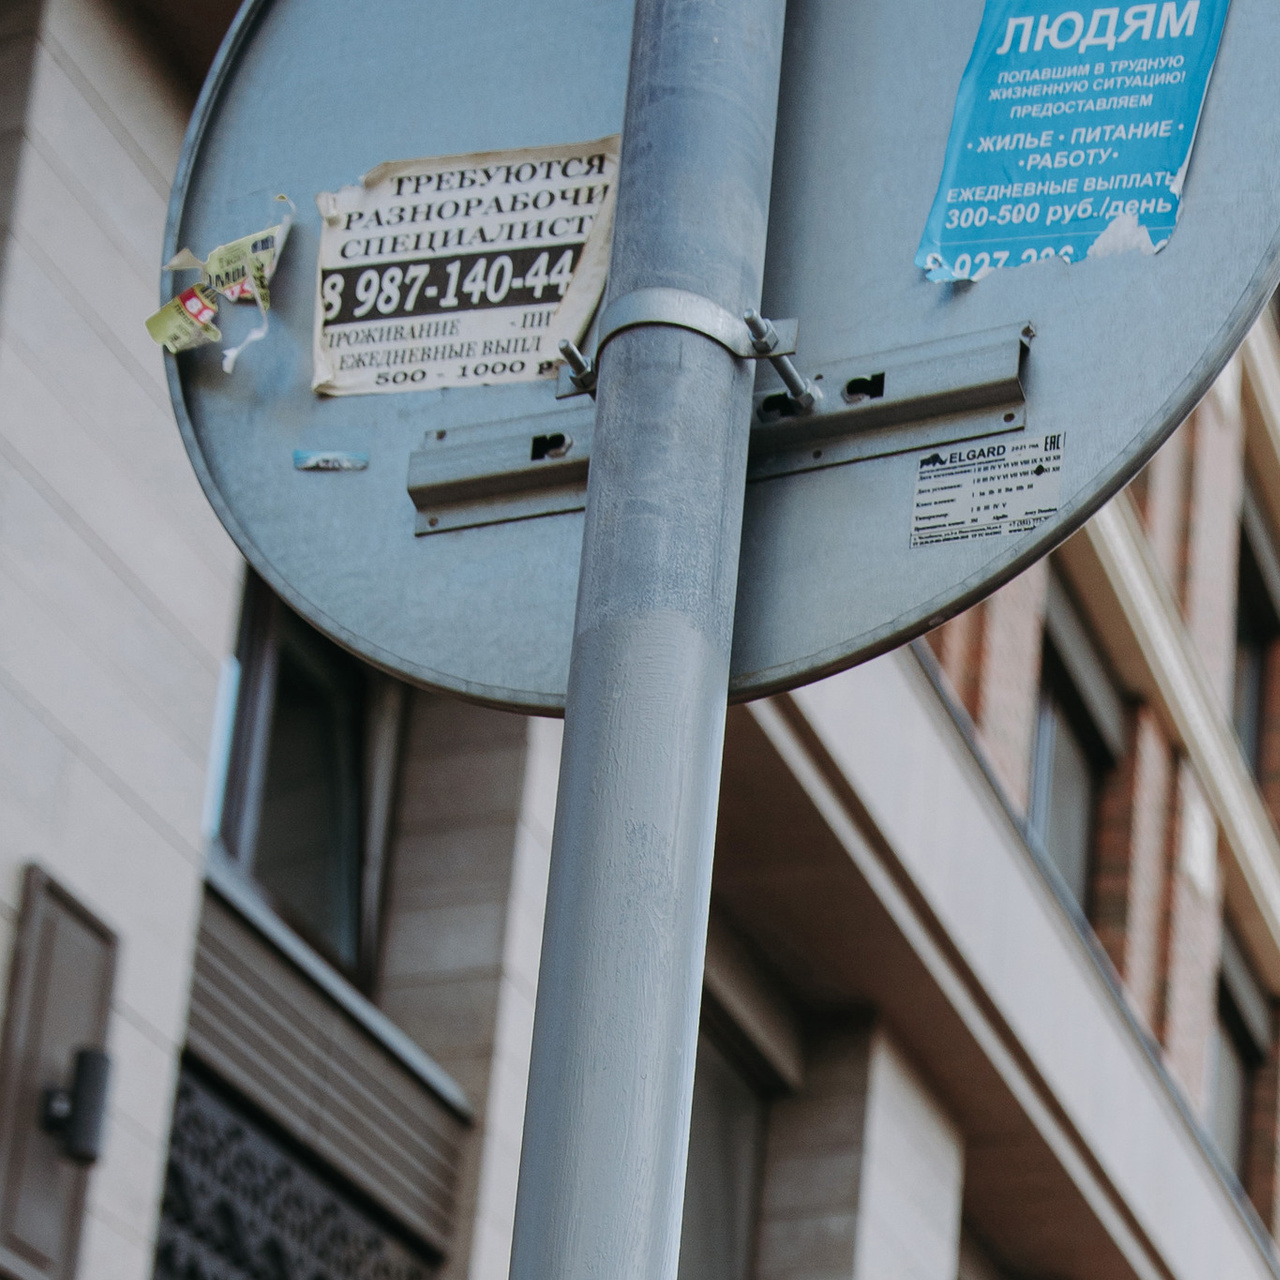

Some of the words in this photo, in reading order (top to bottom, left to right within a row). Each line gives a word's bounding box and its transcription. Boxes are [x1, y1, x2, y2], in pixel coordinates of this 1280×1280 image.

[996, 0, 1201, 54] ЛЮДЯМ
[998, 63, 1090, 84] ПОПАВШИМ
[1094, 62, 1104, 75] В
[1110, 55, 1185, 74] ТРУДНУЮ
[988, 79, 1089, 102] ЖИЗНЕННУЮ
[1093, 71, 1186, 92] СИТУАЦИЮ!
[1010, 94, 1153, 119] ПРЕДОСТАВЛЯЕМ
[977, 130, 1053, 153] ЖИЛЬЕ
[1070, 120, 1173, 145] ПИТАНИЕ
[390, 153, 606, 197] ТРЕБУЮТСЯ
[947, 178, 1079, 204] ЕЖЕДНЕВНЫЕ
[344, 184, 610, 231] РАЗНОРАБОЧИ
[945, 203, 1040, 229] 300-500
[1046, 197, 1173, 227] руб./день
[340, 214, 593, 260] СПЕЦИАЛИСТ
[353, 250, 574, 318] 987-140-44
[338, 341, 477, 371] ЕЖЕДНЕВНЫЕ
[375, 370, 427, 386] 500
[457, 360, 527, 378] 1000
[949, 445, 1006, 464] ELGARD
